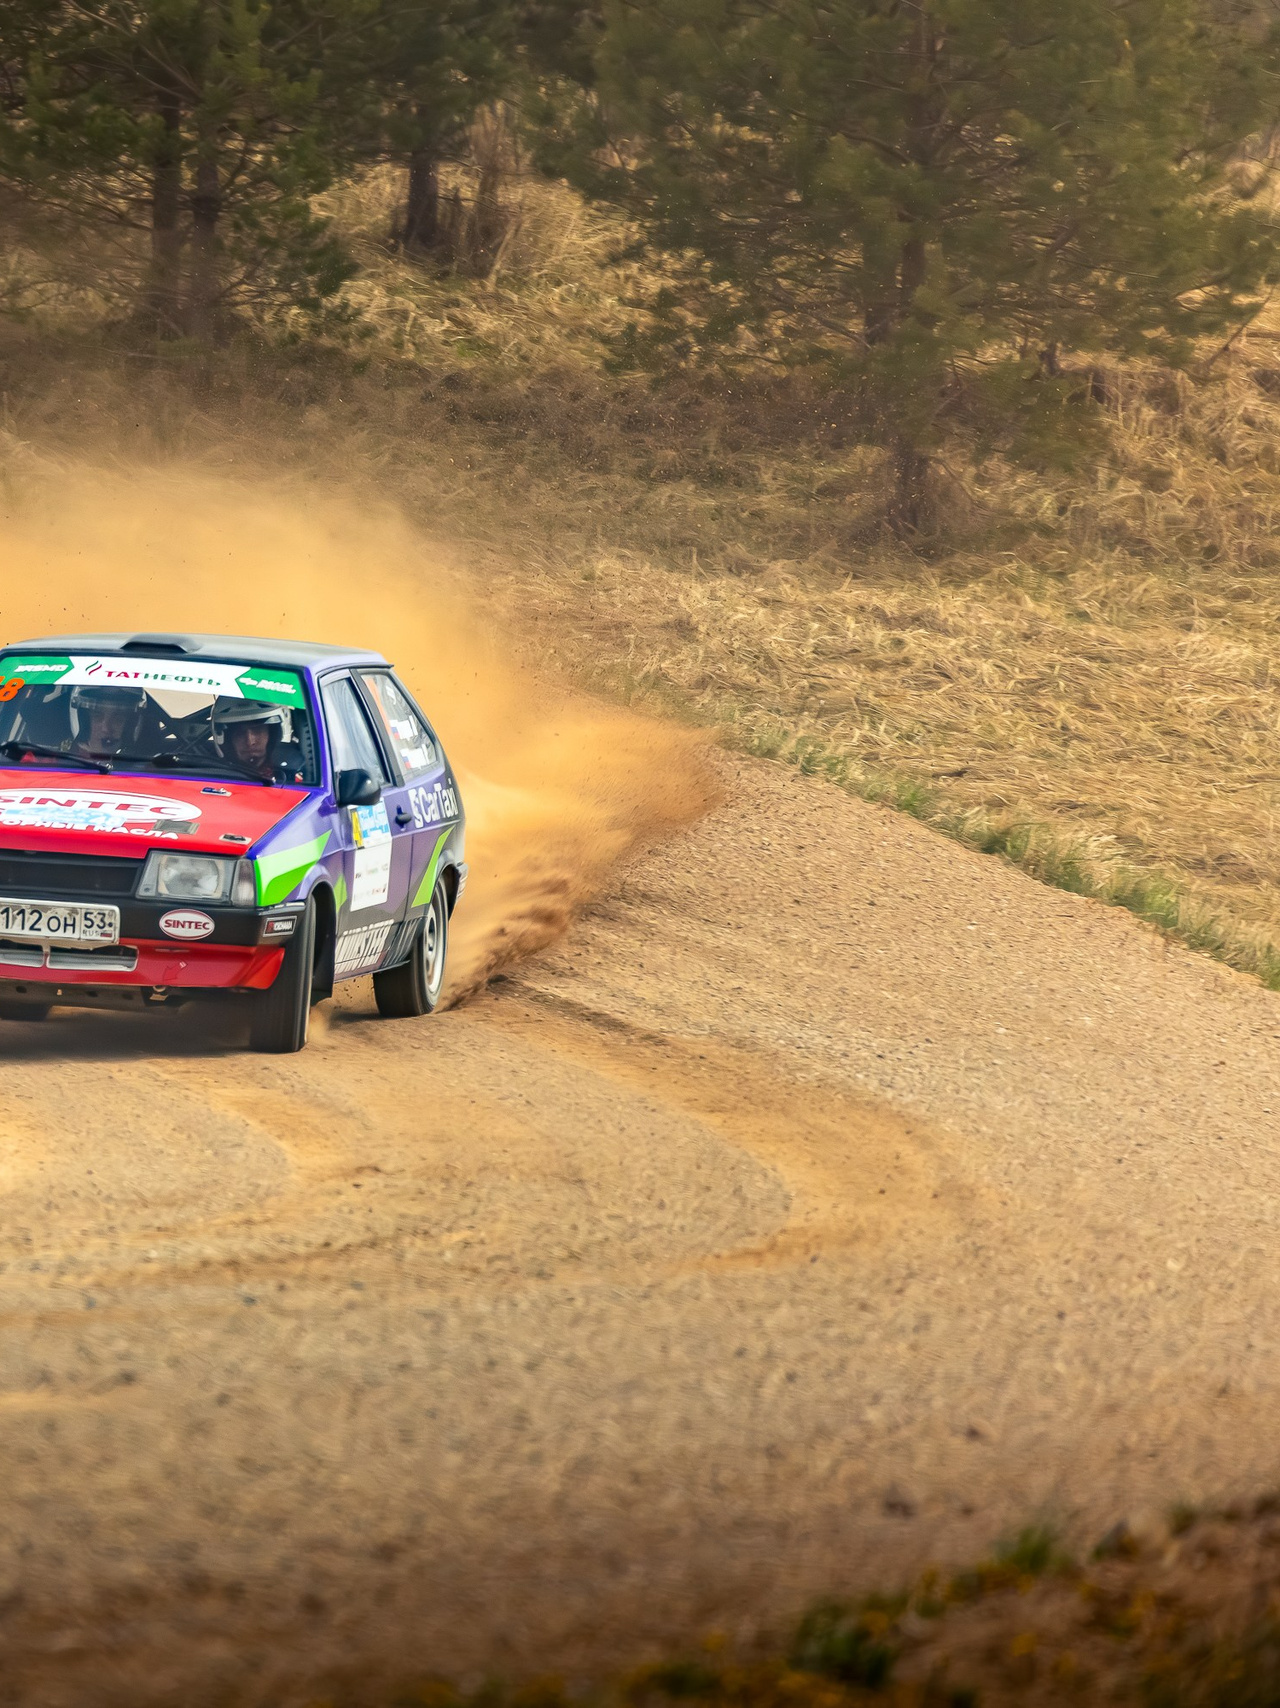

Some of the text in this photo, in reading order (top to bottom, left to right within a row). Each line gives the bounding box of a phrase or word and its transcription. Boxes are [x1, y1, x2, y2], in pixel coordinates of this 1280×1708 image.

[104, 670, 221, 686] ТАТНЕФТЬ
[418, 777, 459, 823] CarTaxi
[93, 824, 179, 840] МАСЛА
[83, 911, 107, 930] 53
[164, 918, 210, 931] SINTEC
